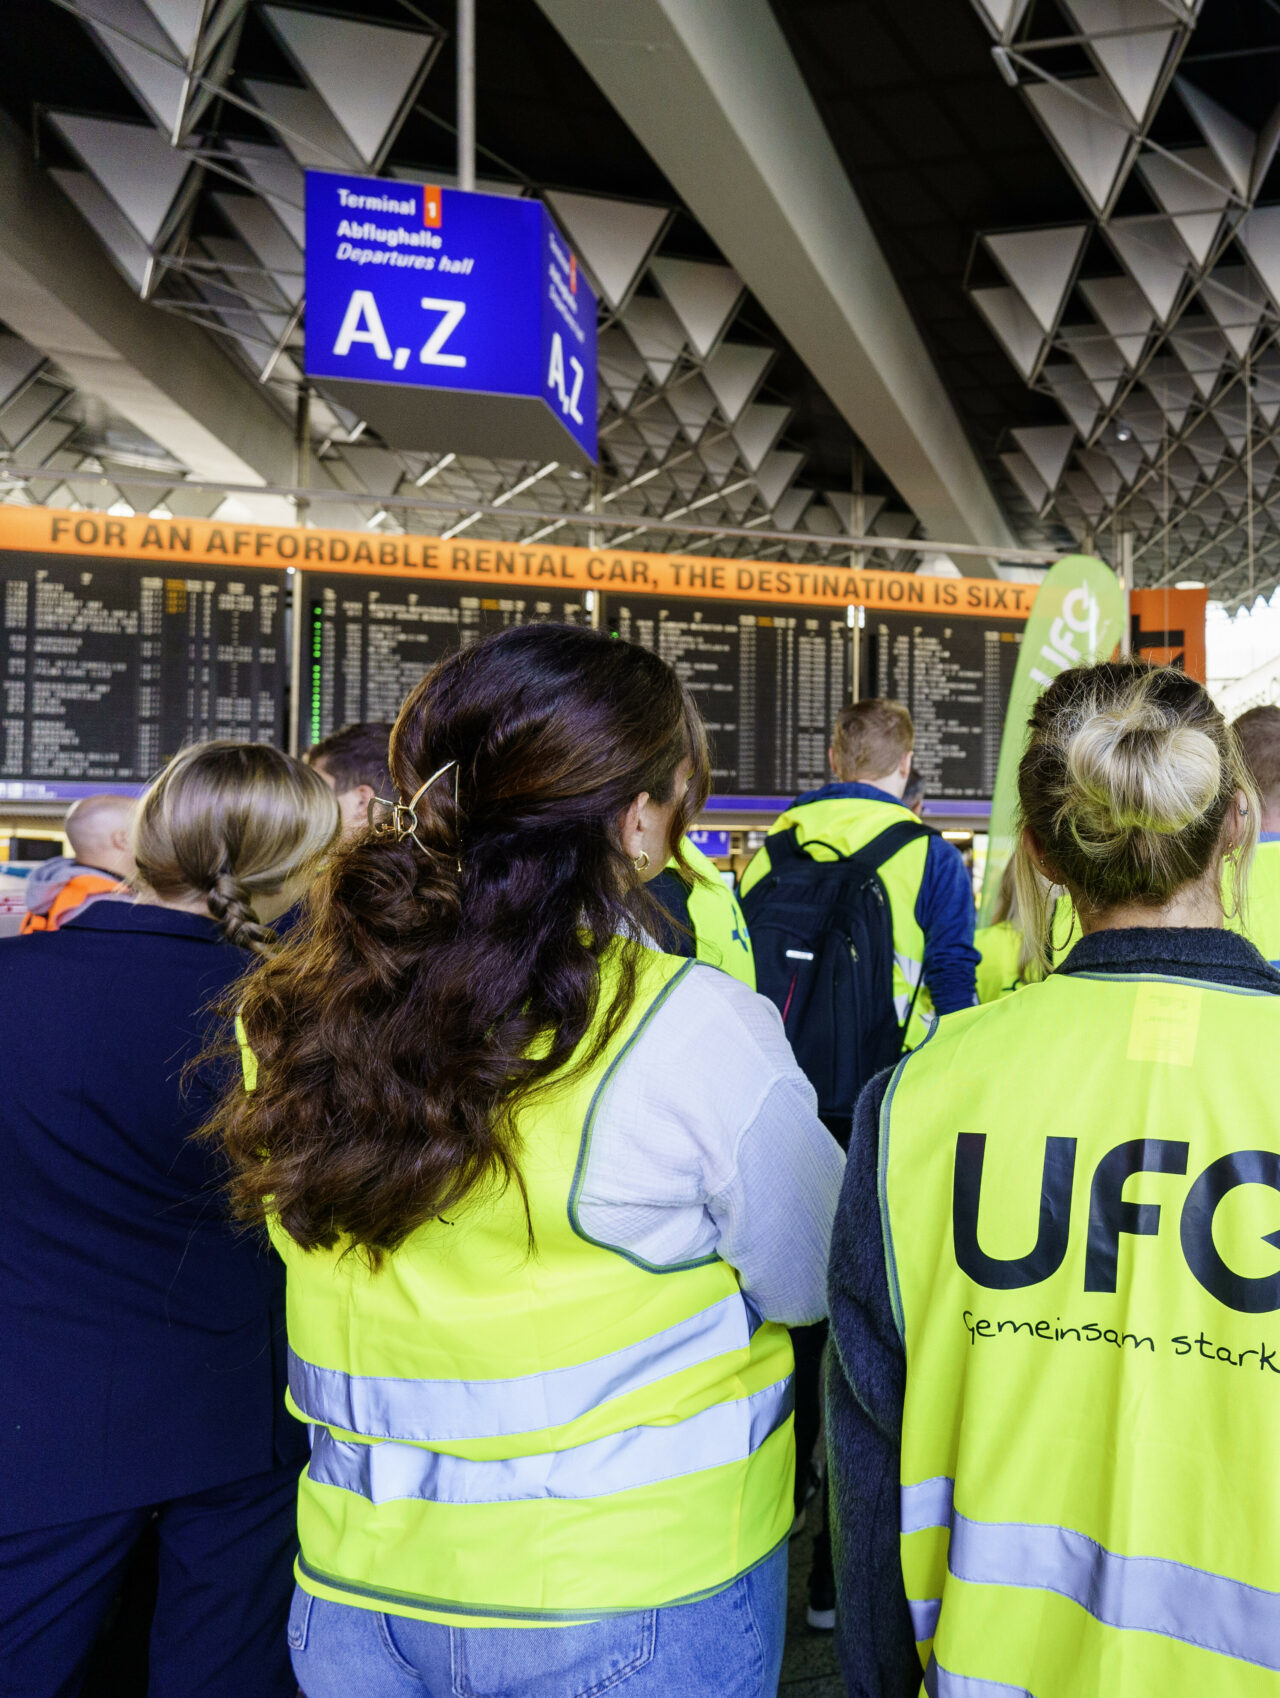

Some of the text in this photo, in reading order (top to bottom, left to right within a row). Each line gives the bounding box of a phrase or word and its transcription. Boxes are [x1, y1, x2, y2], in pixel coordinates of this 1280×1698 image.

[337, 189, 437, 218] Terminal 1
[337, 219, 443, 250] Abflughalle
[336, 242, 475, 275] Departures hall
[51, 517, 1031, 612] FOR AN AFFORDABLE RENTAL CAR, THE DESTINATION IS SIXT.
[962, 1310, 1155, 1352] Gemeinsam
